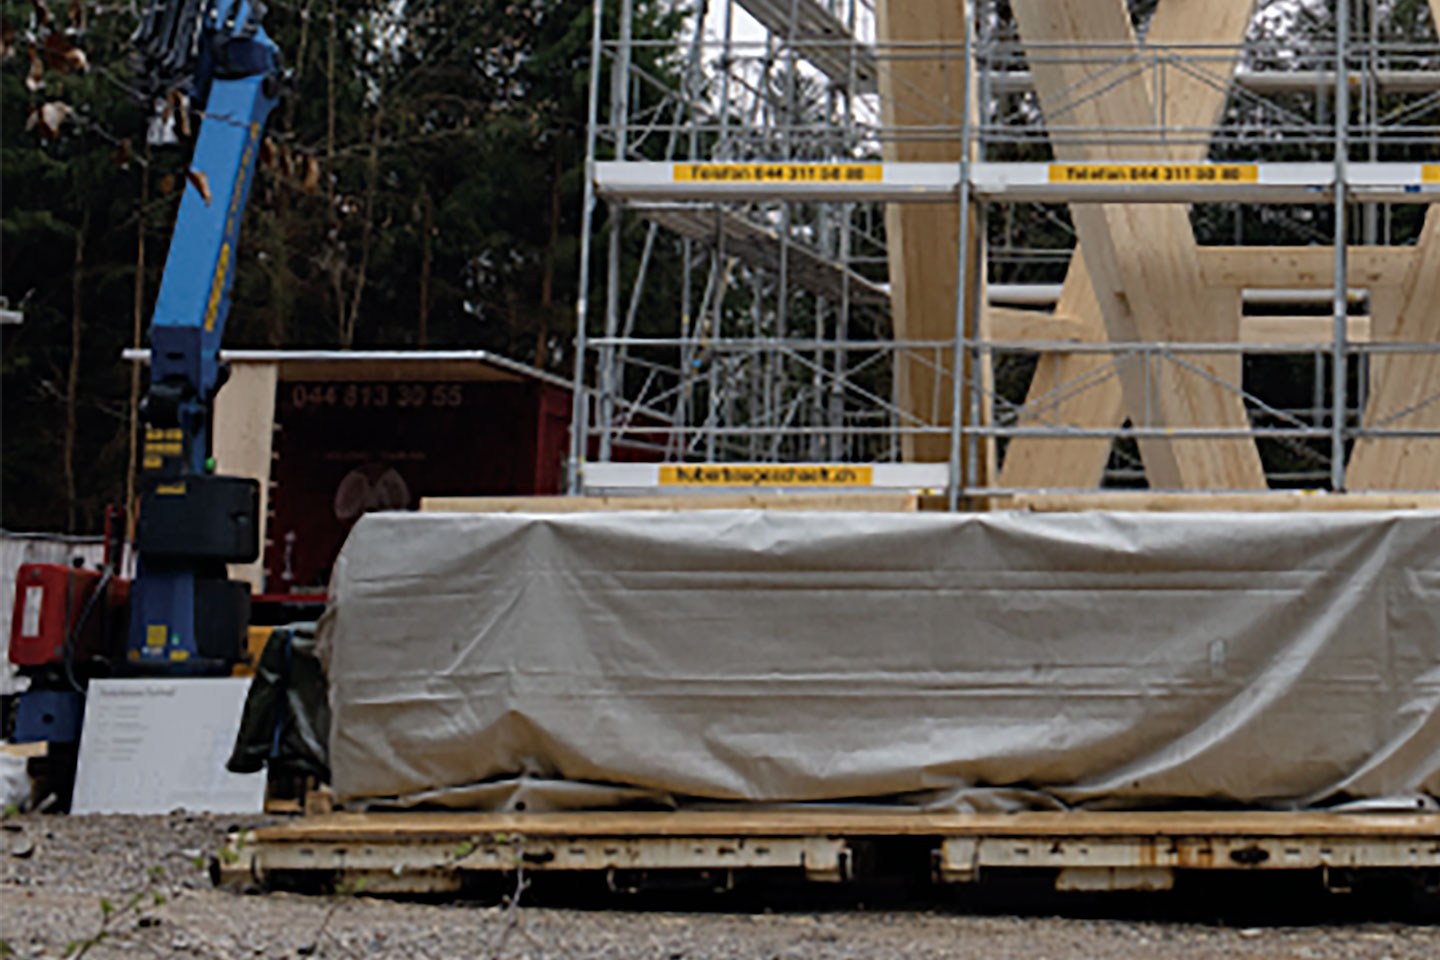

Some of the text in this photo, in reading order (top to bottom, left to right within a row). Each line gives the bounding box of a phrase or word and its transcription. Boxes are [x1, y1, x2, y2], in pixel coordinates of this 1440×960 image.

[293, 386, 335, 407] 044
[344, 386, 388, 407] 813
[432, 386, 463, 407] 55
